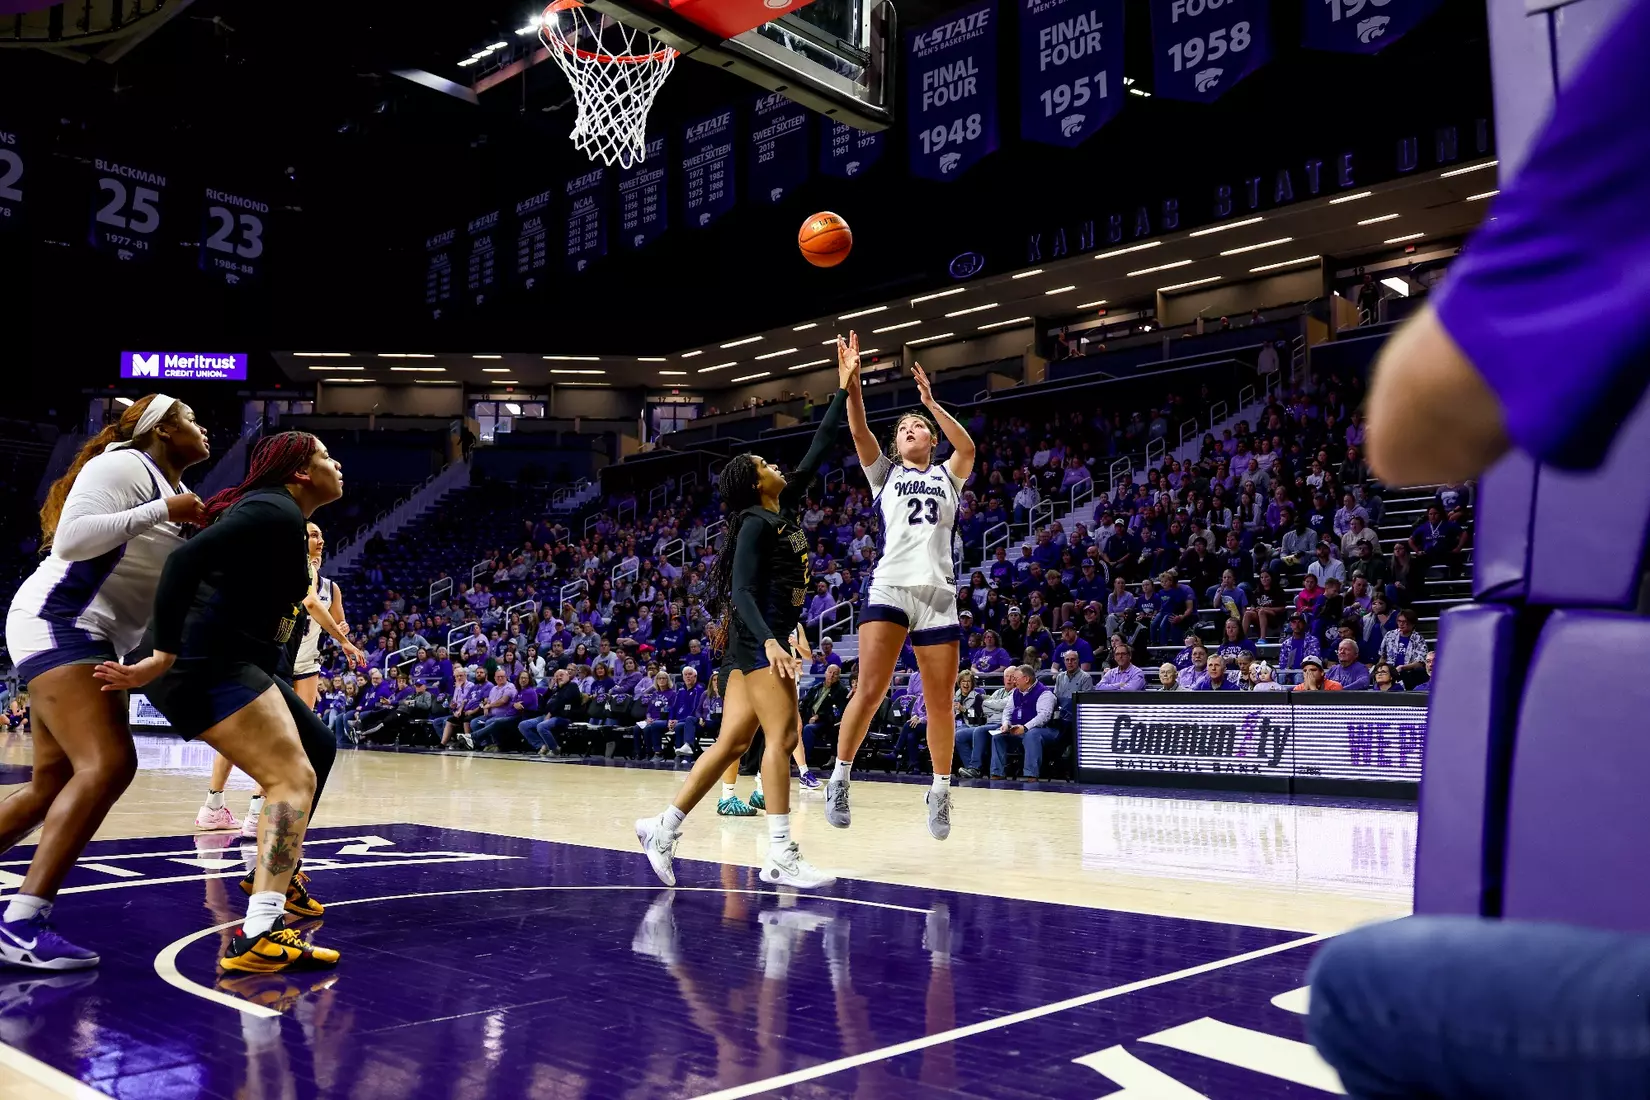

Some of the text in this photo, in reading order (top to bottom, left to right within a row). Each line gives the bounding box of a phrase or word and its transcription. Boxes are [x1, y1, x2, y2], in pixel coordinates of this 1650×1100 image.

[1171, 0, 1234, 24] FOU
[913, 8, 991, 52] K-STATE
[917, 28, 985, 58] MEN'S BASKETBALL
[1040, 10, 1103, 50] FINAL
[1040, 32, 1102, 72] FOUR
[1167, 21, 1251, 73] 1958
[923, 56, 979, 91] FINAL
[923, 76, 977, 112] FOUR
[1040, 70, 1108, 118] 1951
[686, 112, 731, 140] K-STATE
[752, 114, 805, 142] SWEET SIXTEEN
[832, 134, 850, 146] 1959
[919, 113, 982, 155] 1948
[682, 143, 732, 169] SWEET SIXTEEN
[758, 141, 776, 154] 2018
[832, 145, 849, 157] 1961
[857, 136, 876, 148] 1975
[758, 151, 775, 163] 2023
[94, 159, 166, 187] BLACKMAN
[689, 168, 704, 180] 1972
[96, 177, 160, 234] 25
[205, 188, 269, 214] RICHMOND
[1026, 151, 1355, 263] KANSAS STATE
[206, 206, 263, 259] 23
[213, 257, 254, 274] 1986-88
[164, 354, 236, 369] Meritrust
[164, 369, 194, 377] CREDIT
[894, 480, 947, 500] Wildcats
[907, 497, 939, 526] 23
[1115, 760, 1261, 774] NATIONAL BANK
